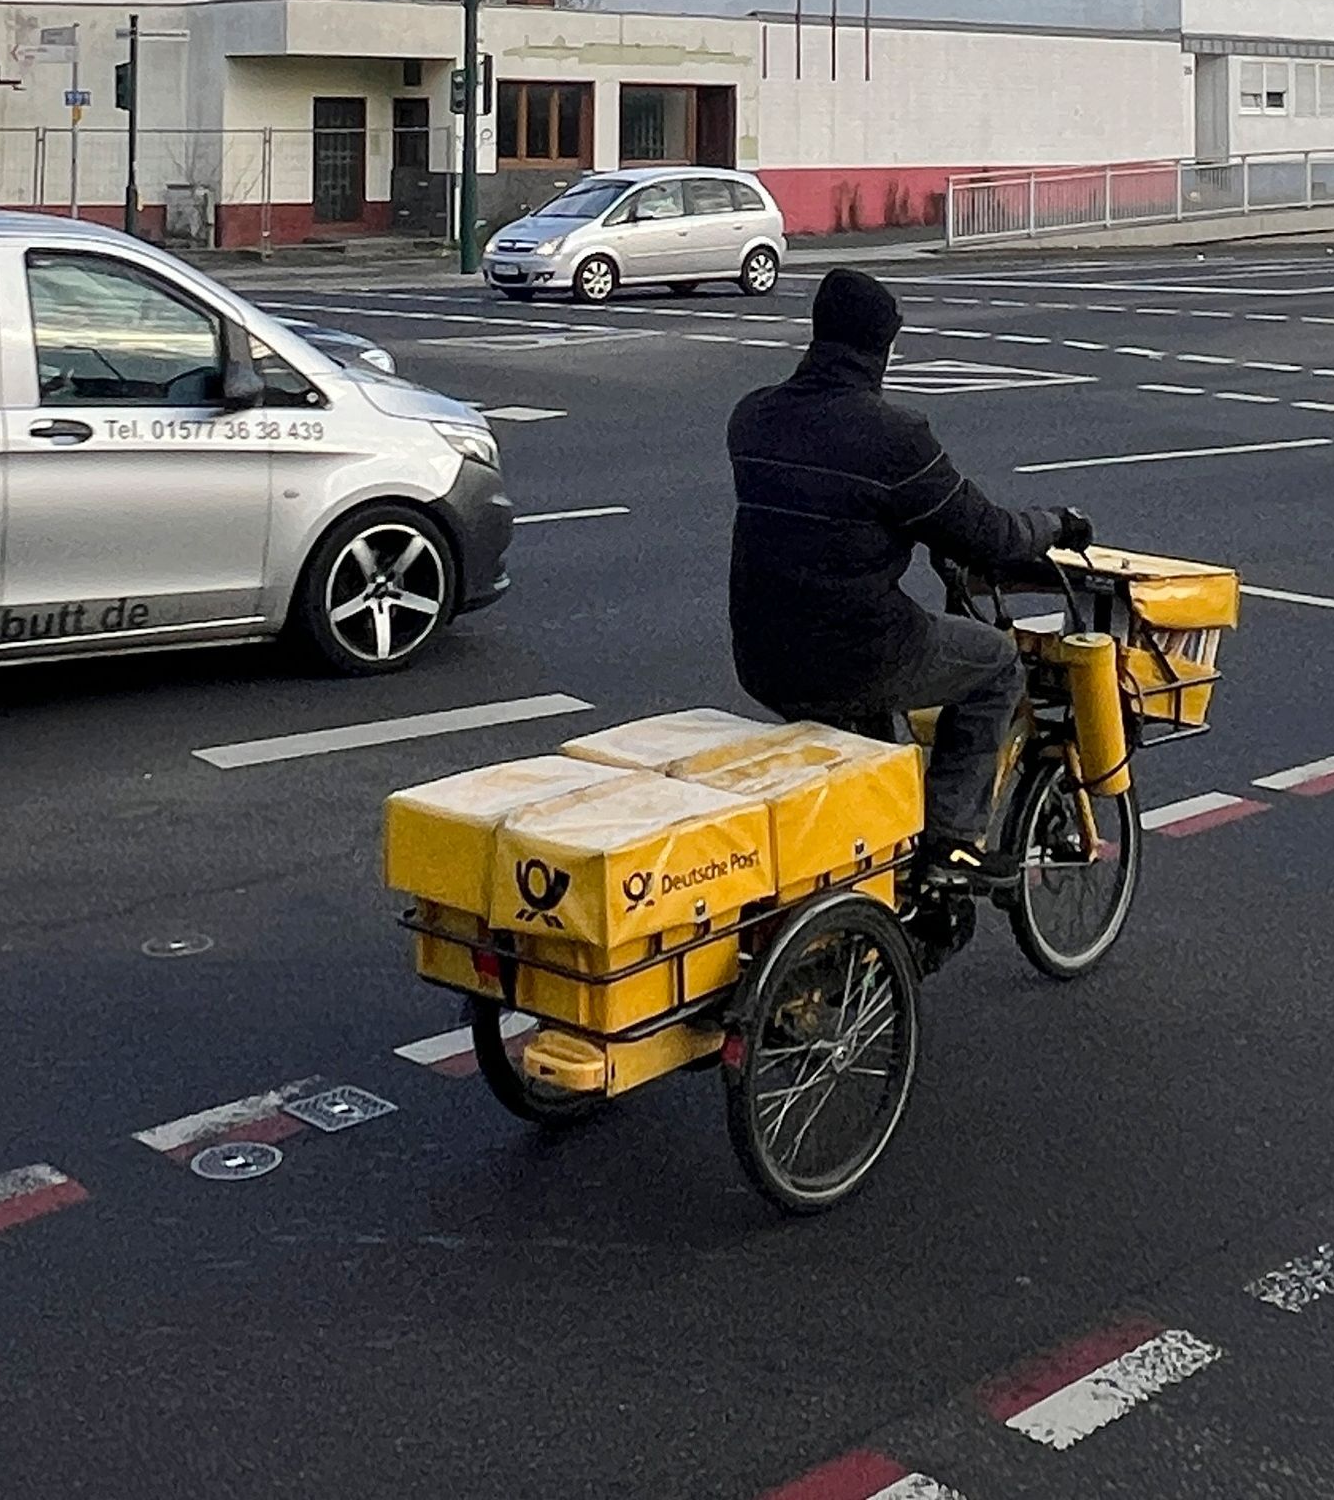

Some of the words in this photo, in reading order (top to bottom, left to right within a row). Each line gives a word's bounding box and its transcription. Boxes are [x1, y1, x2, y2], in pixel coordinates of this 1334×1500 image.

[104, 419, 145, 440] Tel.
[151, 419, 217, 440] 01577
[288, 421, 324, 441] 439
[661, 857, 728, 896] Deutsche
[730, 849, 760, 875] Post
